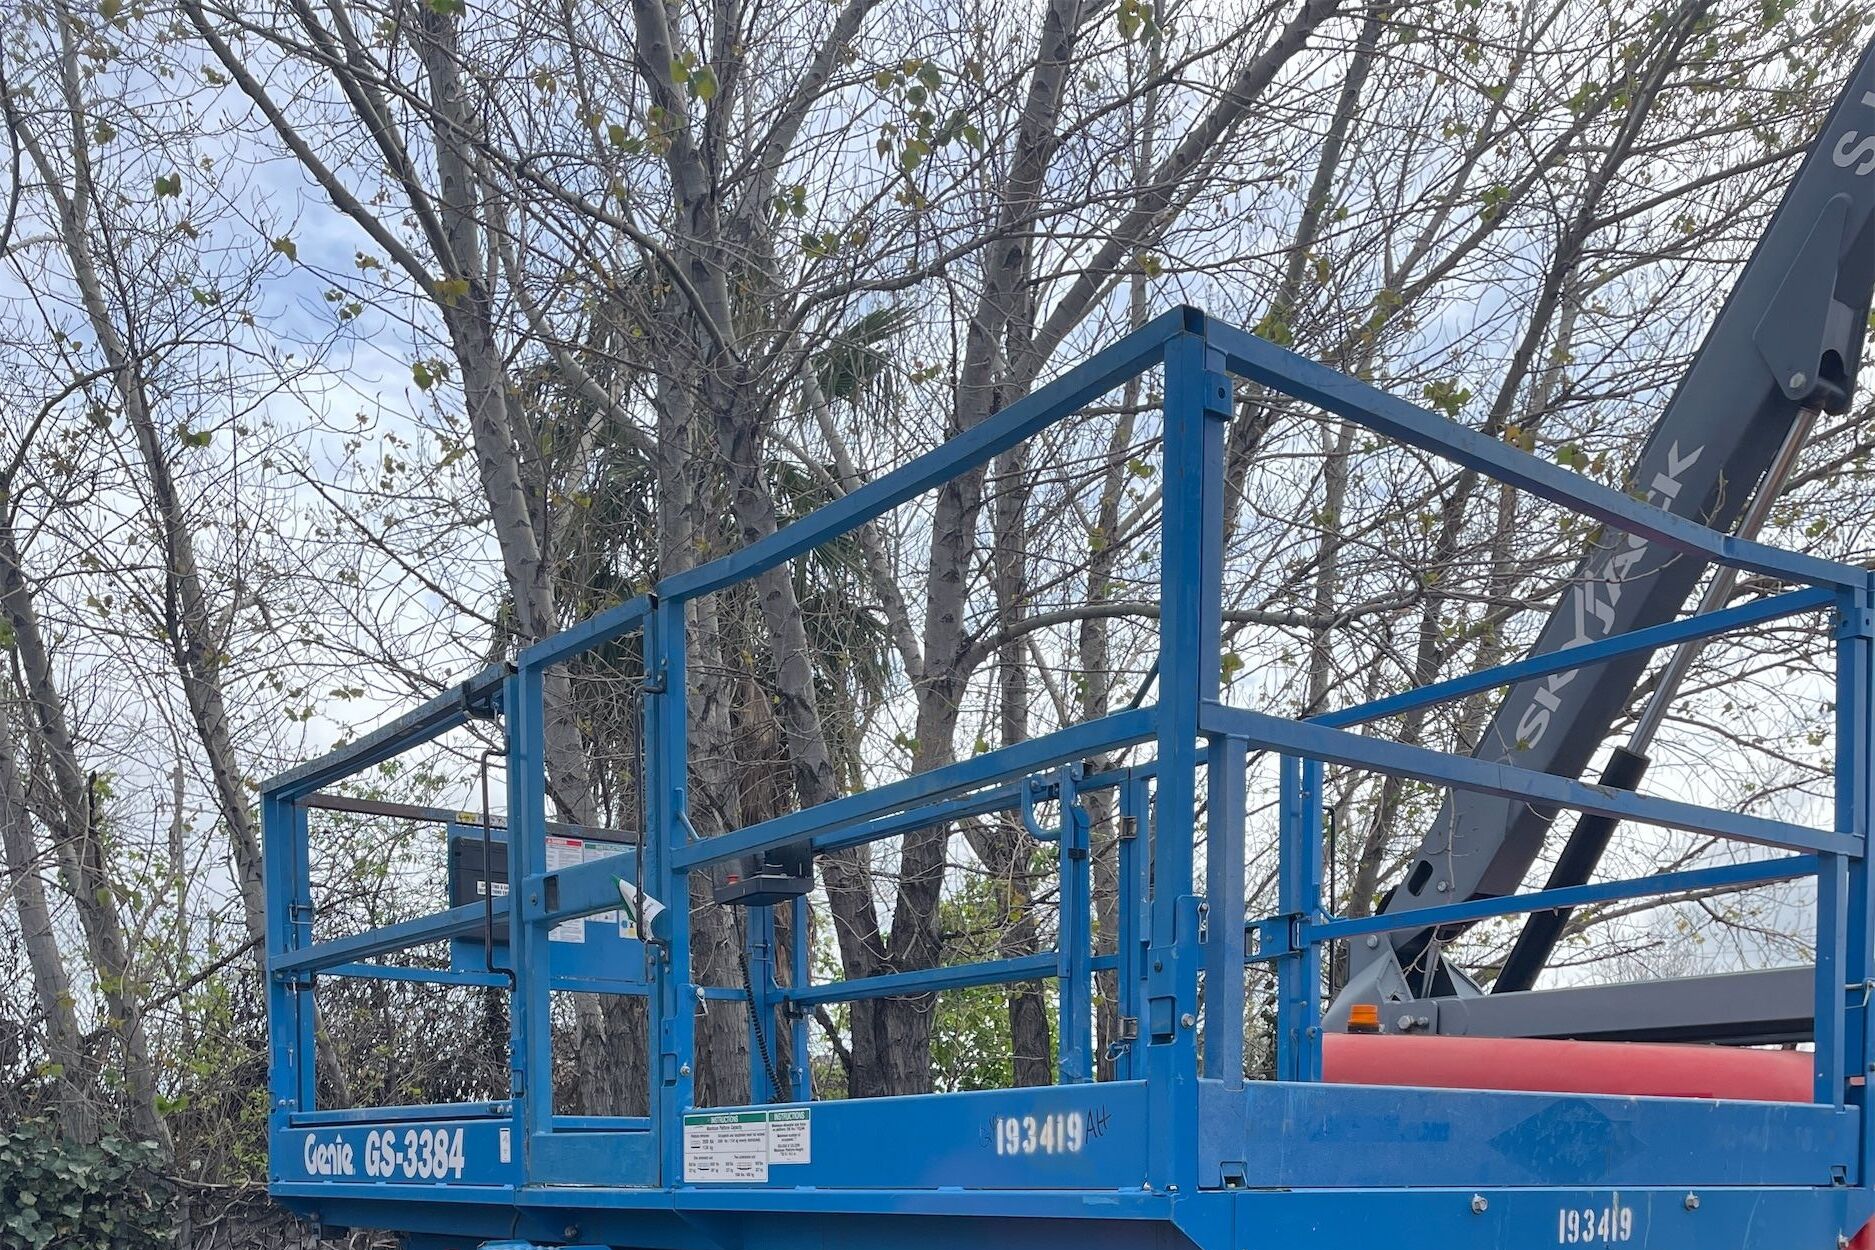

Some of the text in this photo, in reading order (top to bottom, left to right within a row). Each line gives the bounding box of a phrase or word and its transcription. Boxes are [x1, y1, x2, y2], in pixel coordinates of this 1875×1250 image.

[774, 1111, 805, 1121] INSTRUCTIONS
[996, 1113, 1083, 1155] 193419
[304, 1133, 354, 1176] Genie
[365, 1128, 465, 1179] GS-3384
[1559, 1207, 1633, 1244] 193419
